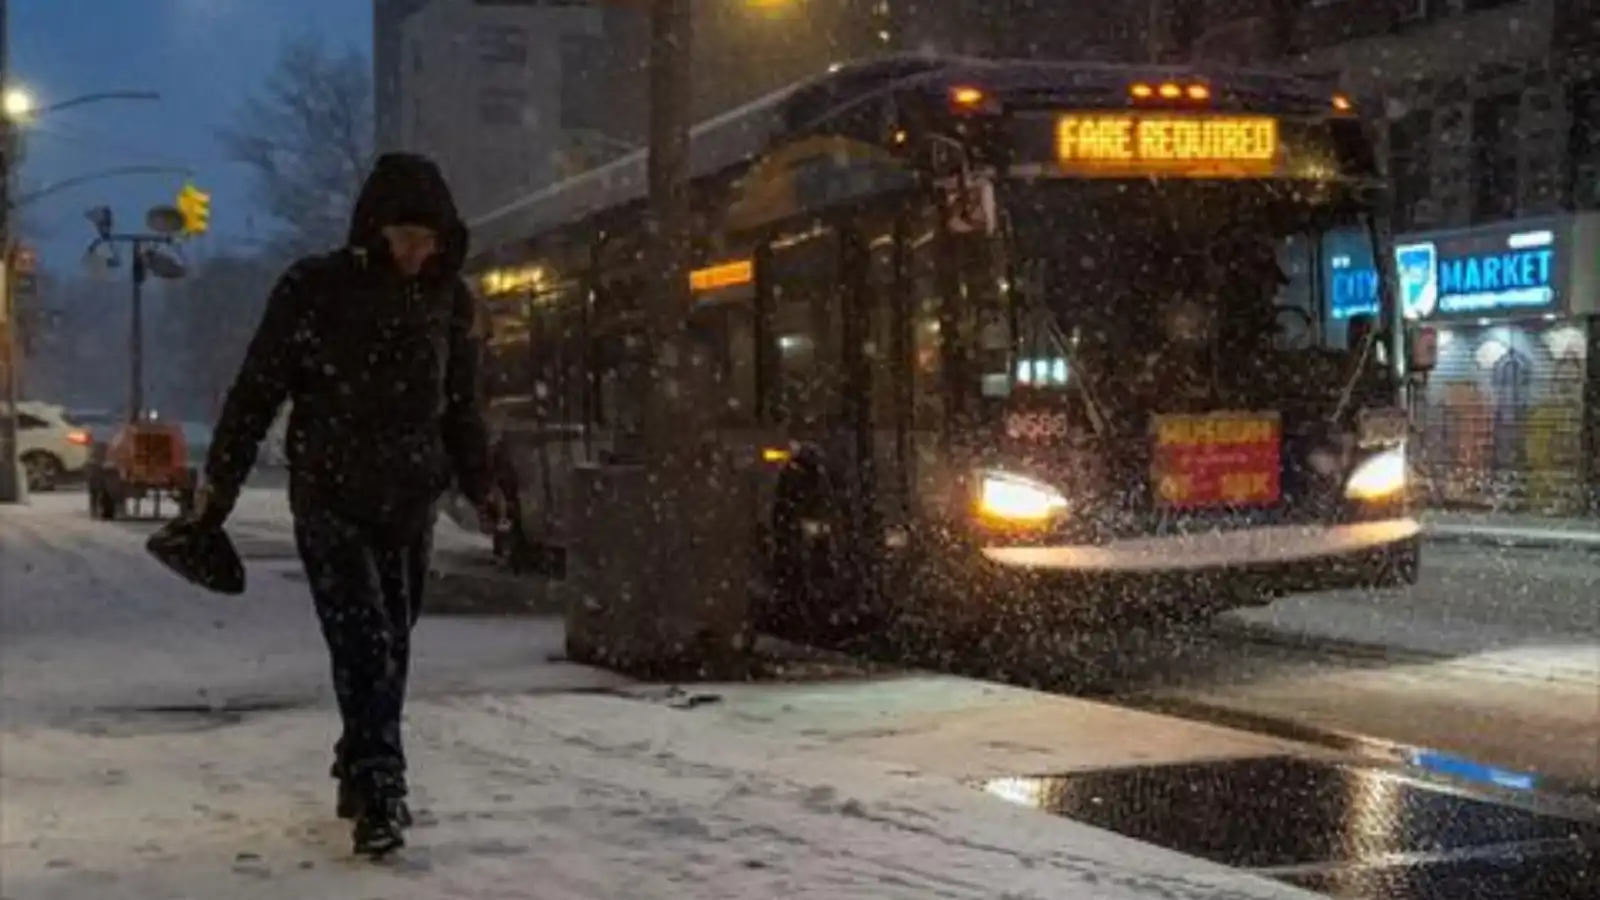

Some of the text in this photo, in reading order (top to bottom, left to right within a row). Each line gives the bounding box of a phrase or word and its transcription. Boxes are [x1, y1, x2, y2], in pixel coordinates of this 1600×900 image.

[1058, 117, 1275, 159] FARE REQUIRED
[1440, 250, 1553, 293] MARKET
